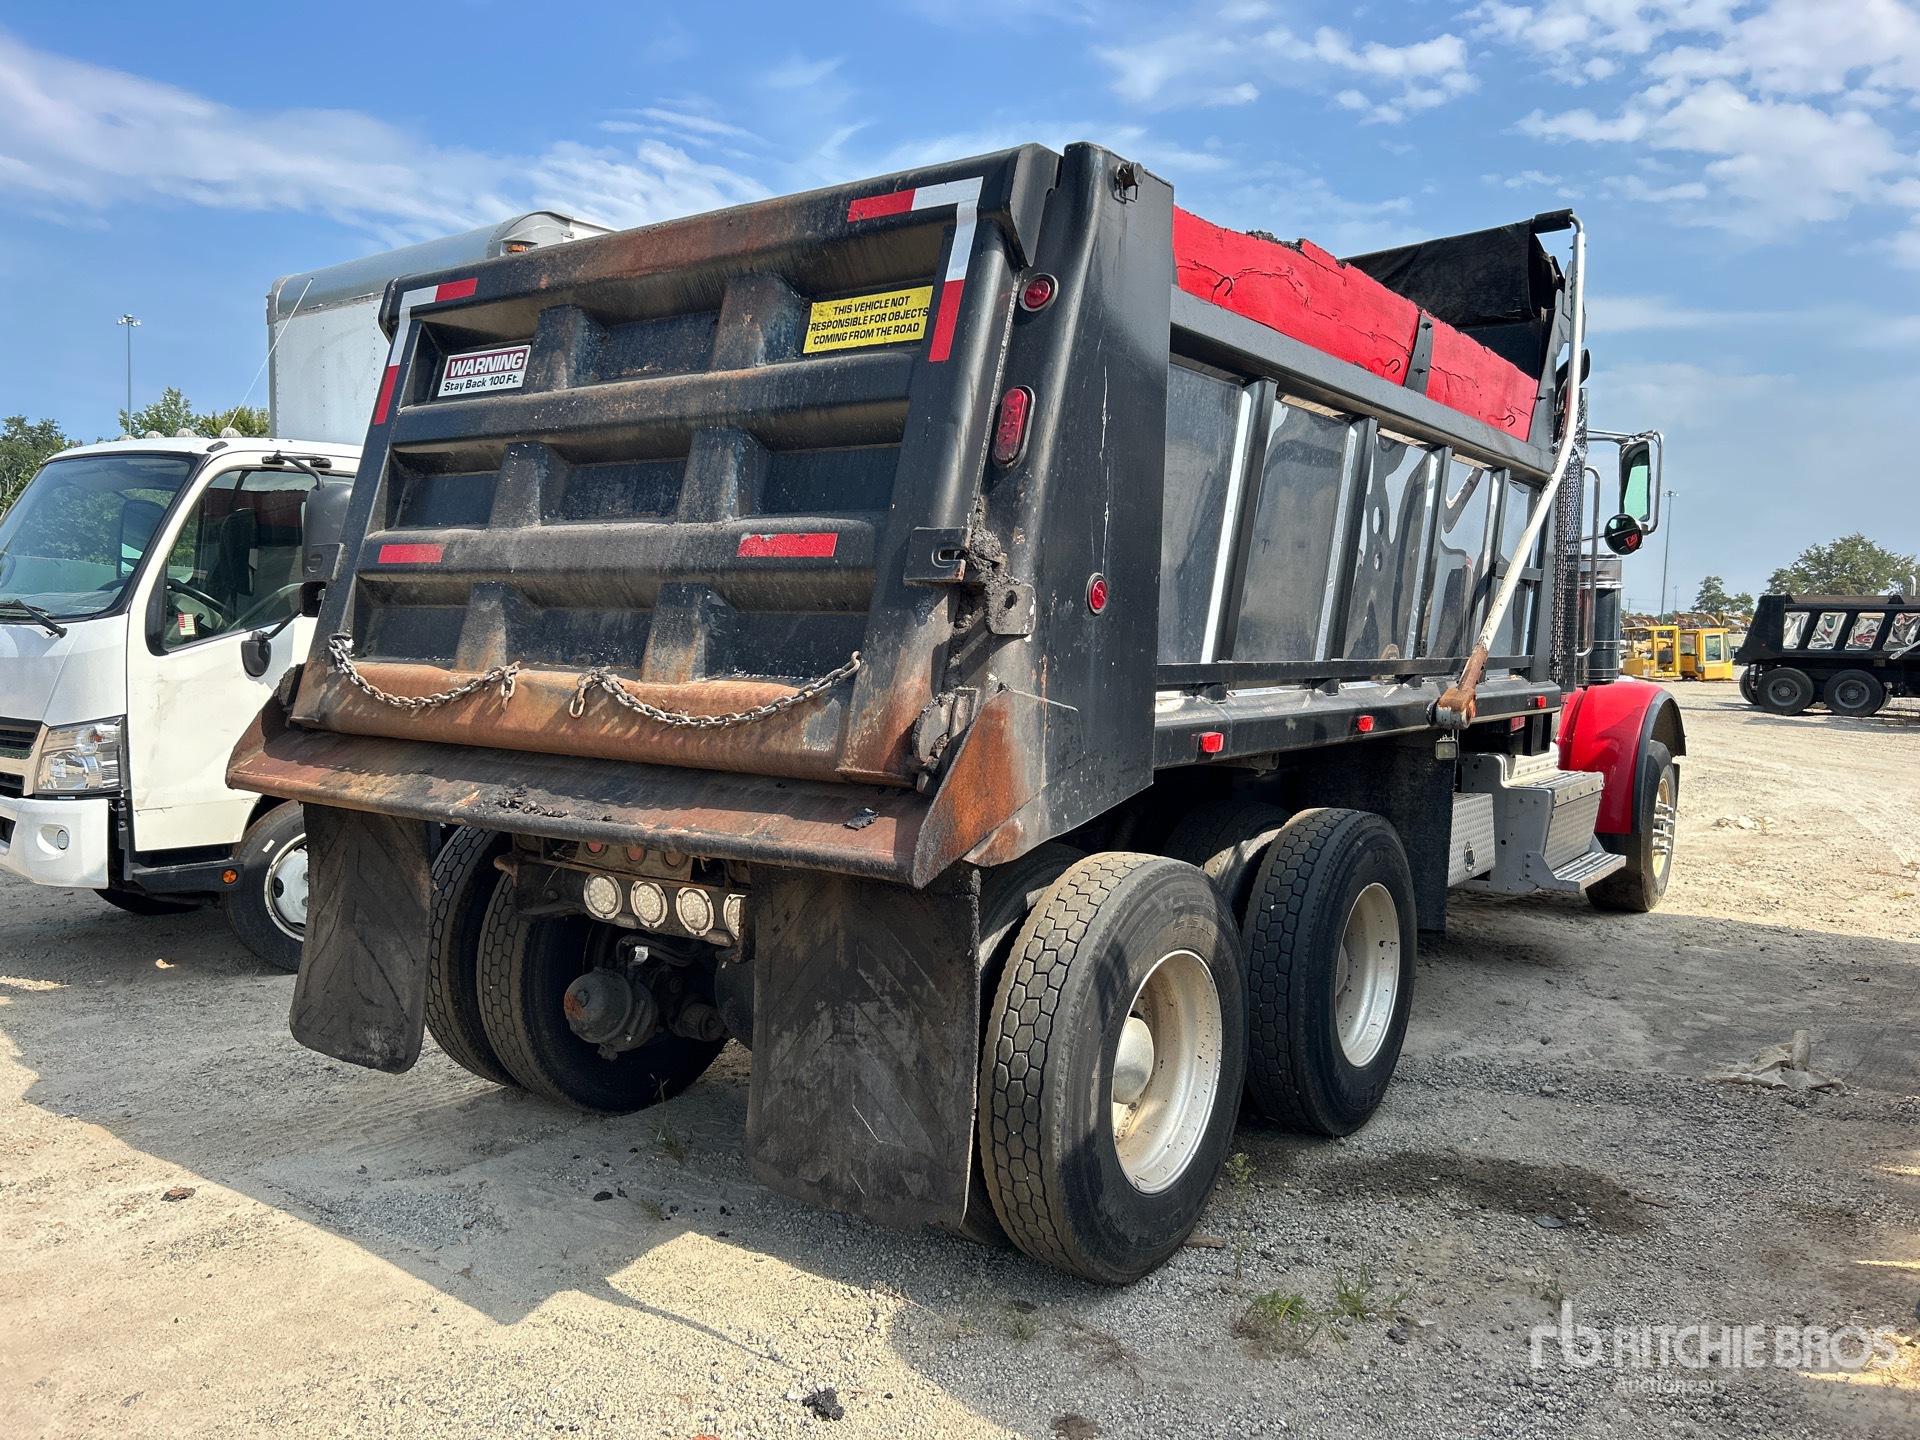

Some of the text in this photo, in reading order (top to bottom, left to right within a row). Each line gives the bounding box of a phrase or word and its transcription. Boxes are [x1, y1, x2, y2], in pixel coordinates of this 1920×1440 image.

[834, 295, 910, 315] THIS VEHICLE NOT
[810, 306, 929, 332] RESPONSIBLE FOR OBJECTS
[813, 322, 920, 345] COMING FROM THE ROAD
[450, 352, 524, 377] WARNING
[443, 373, 519, 392] Stay Back 100 Ft.
